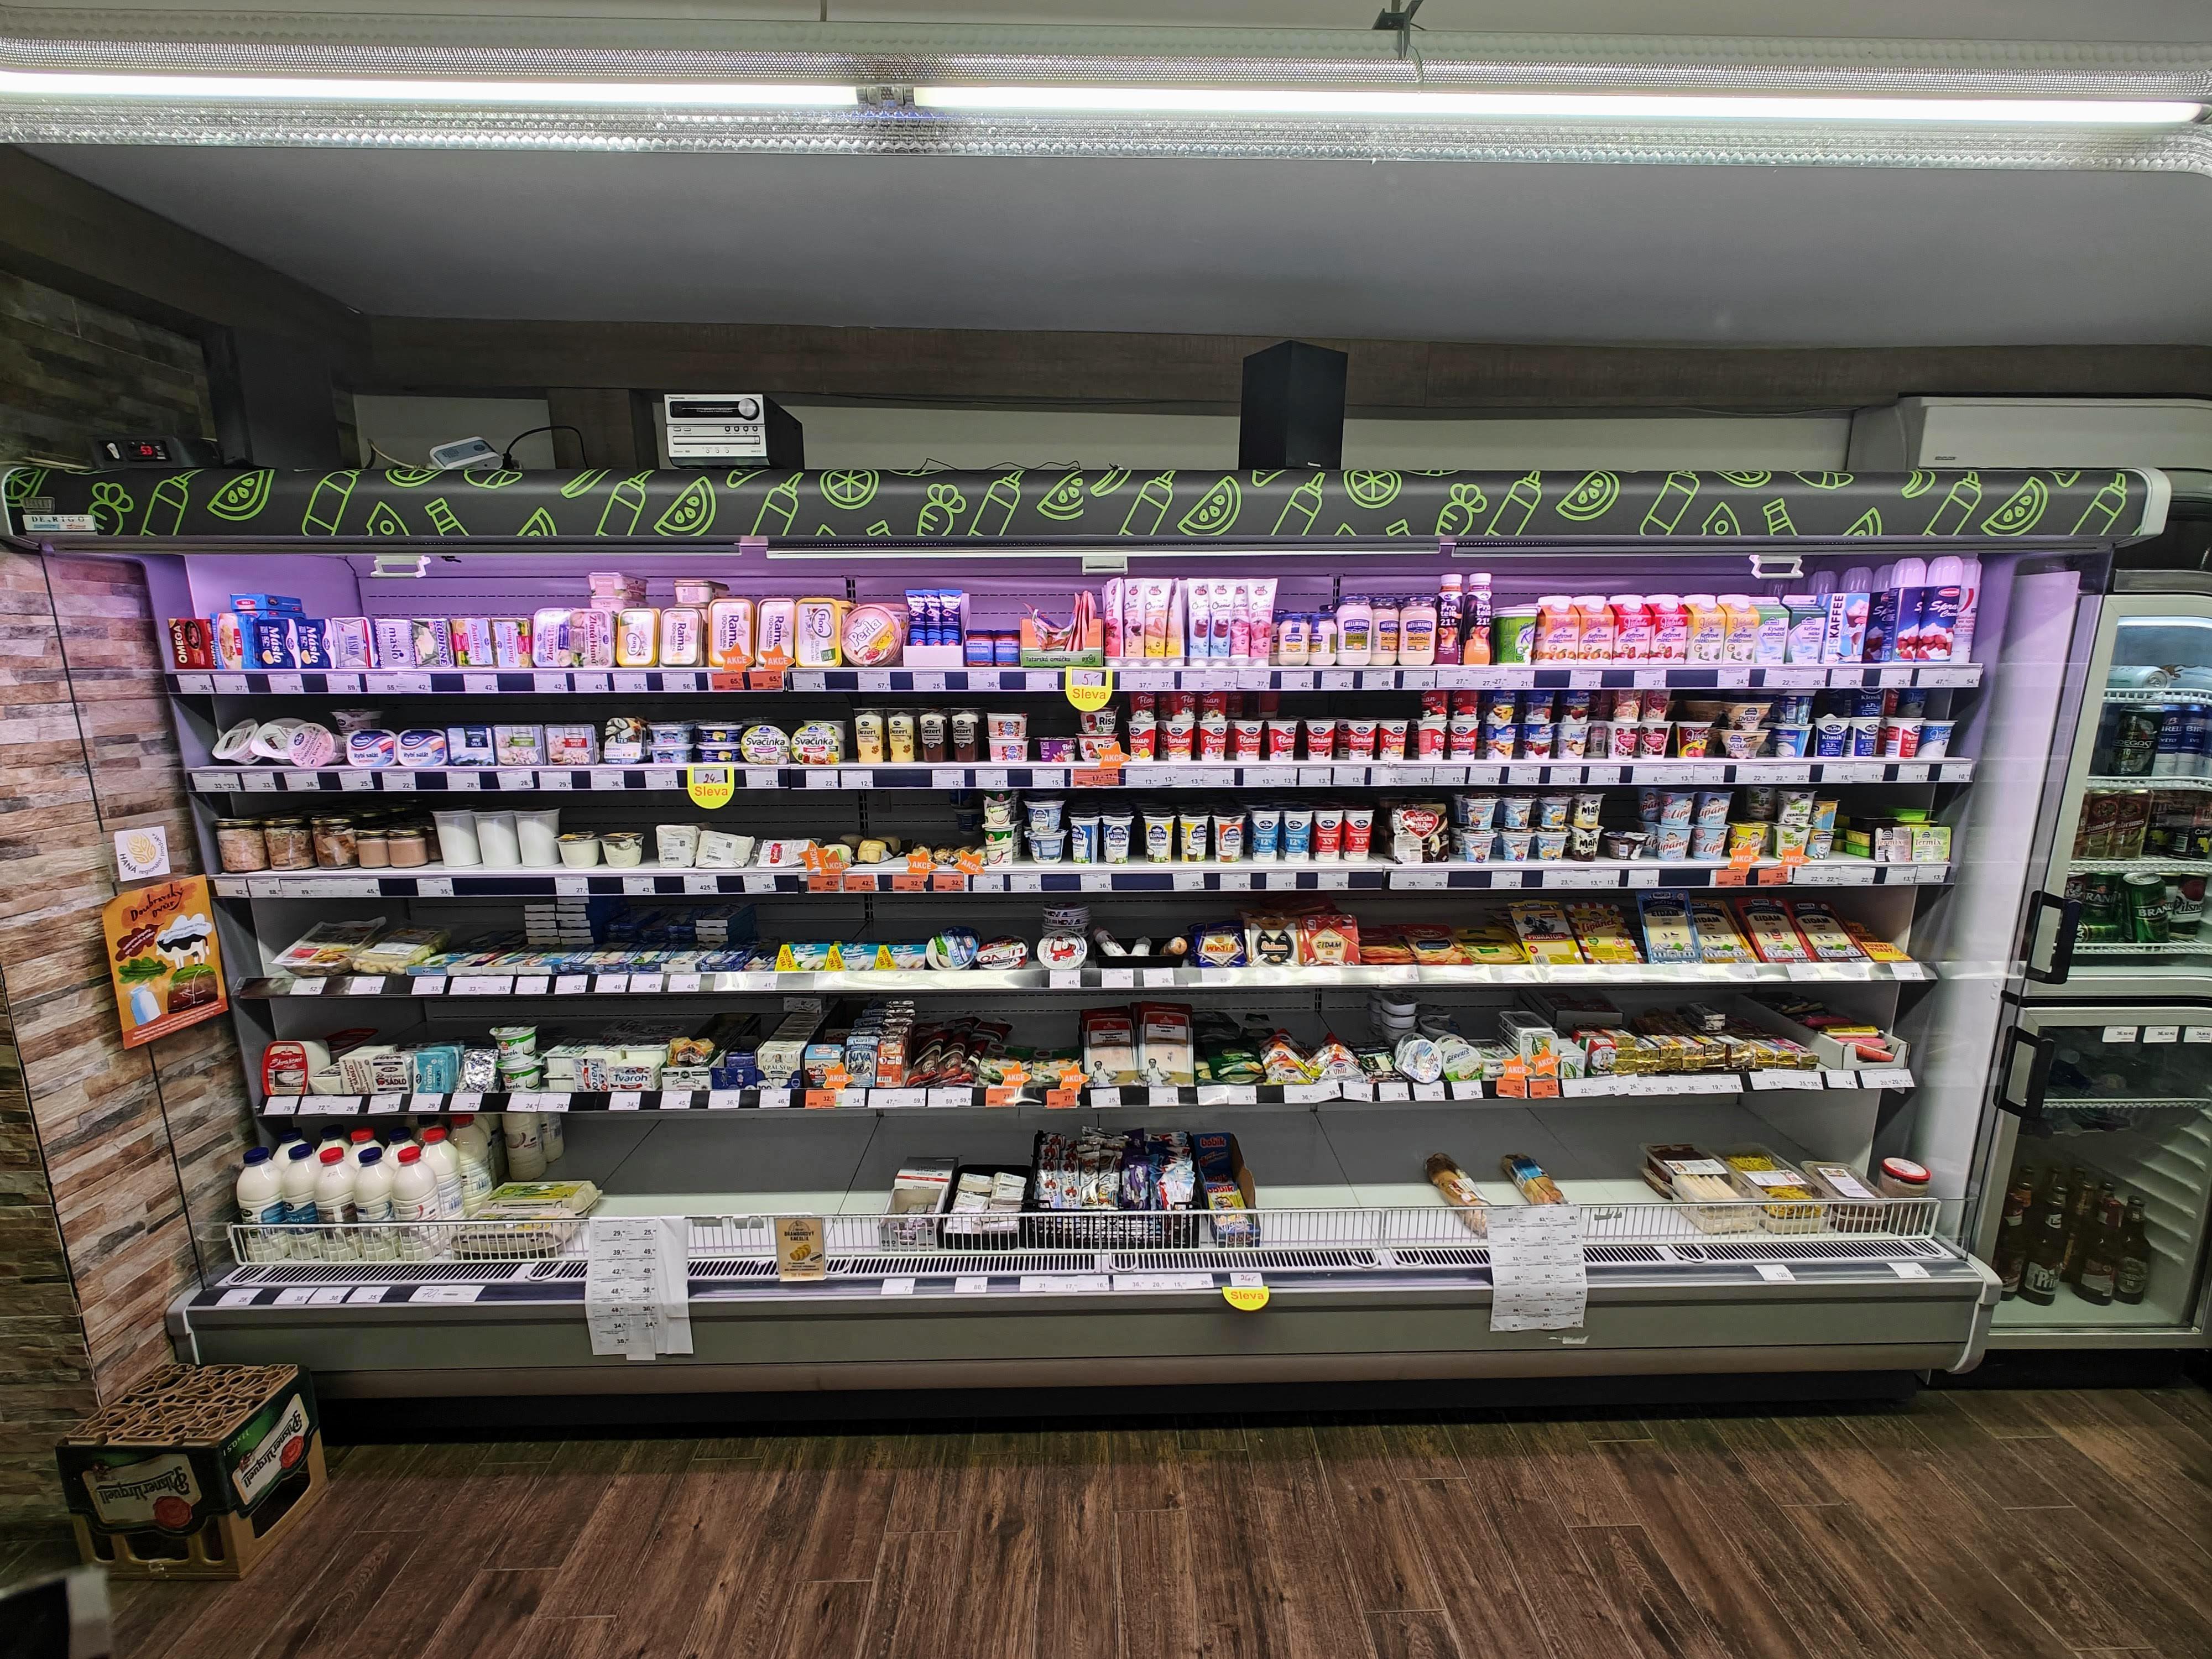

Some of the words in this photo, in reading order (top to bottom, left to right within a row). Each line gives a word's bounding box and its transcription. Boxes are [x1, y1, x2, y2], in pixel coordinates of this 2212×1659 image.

[1477, 602, 1491, 611] Pro
[774, 615, 784, 646] Rama
[1344, 620, 1369, 629] HELLMANN'S
[1407, 620, 1432, 630] HELLMANN'S
[1827, 594, 1844, 655] EISKAFFEE
[677, 623, 686, 651] Rama
[729, 615, 739, 649] Rama
[848, 618, 883, 647] Perla
[173, 625, 188, 664] OMEGA
[269, 625, 283, 664] Máslo
[306, 625, 319, 664] Máslo
[388, 627, 399, 660] máslo
[727, 655, 747, 664] AKCE
[1072, 688, 1106, 700] Sleva
[1099, 717, 1115, 725] Riso
[746, 737, 785, 746] Svačinka
[795, 735, 834, 745] Svačinka
[1104, 754, 1124, 762] AKCE
[694, 786, 729, 797] Sleva
[119, 853, 137, 873] HANÁ
[807, 847, 817, 866] AKCE
[1734, 855, 1754, 863] AKCE
[911, 861, 931, 869] AKCE
[961, 859, 981, 873] AKCE
[2174, 895, 2203, 916] Pilsne
[1582, 917, 1617, 933] Lipánek
[851, 1052, 872, 1062] NIVA
[1446, 1048, 1470, 1064] GERVAIS
[1538, 1057, 1555, 1066] AKCE
[1508, 1066, 1526, 1074] AKCE
[385, 1078, 407, 1086] SÁDLO
[614, 1074, 648, 1082] Tvaroh
[1200, 1138, 1227, 1147] bobik
[1230, 1290, 1265, 1300] Sleva
[271, 1409, 302, 1455] Pilsner
[242, 1444, 278, 1488] Urquell
[144, 1465, 191, 1495] Pilsner
[98, 1484, 148, 1504] Urquell
